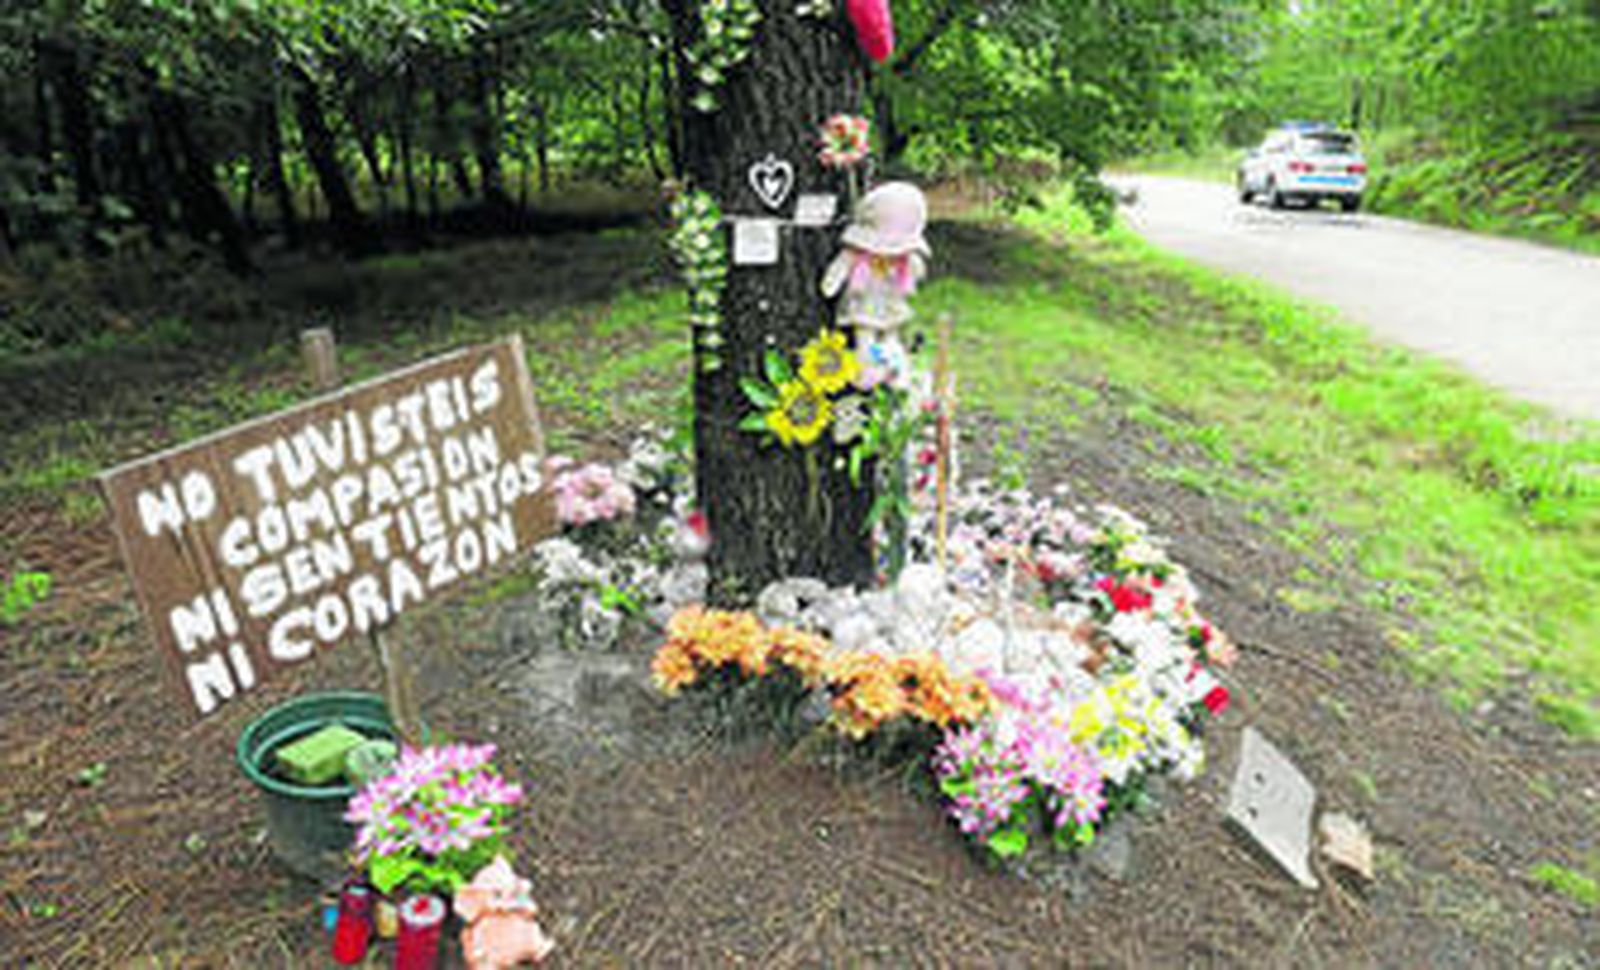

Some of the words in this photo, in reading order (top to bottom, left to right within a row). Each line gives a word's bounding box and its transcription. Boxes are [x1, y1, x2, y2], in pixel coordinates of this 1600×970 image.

[138, 471, 216, 537] NO
[233, 357, 501, 502] TUVISTEIS
[218, 426, 501, 568] COMPASION
[169, 587, 238, 653] NI
[240, 452, 543, 617] SENTIENTOS
[185, 642, 256, 714] NI
[267, 511, 518, 662] CORAZON
